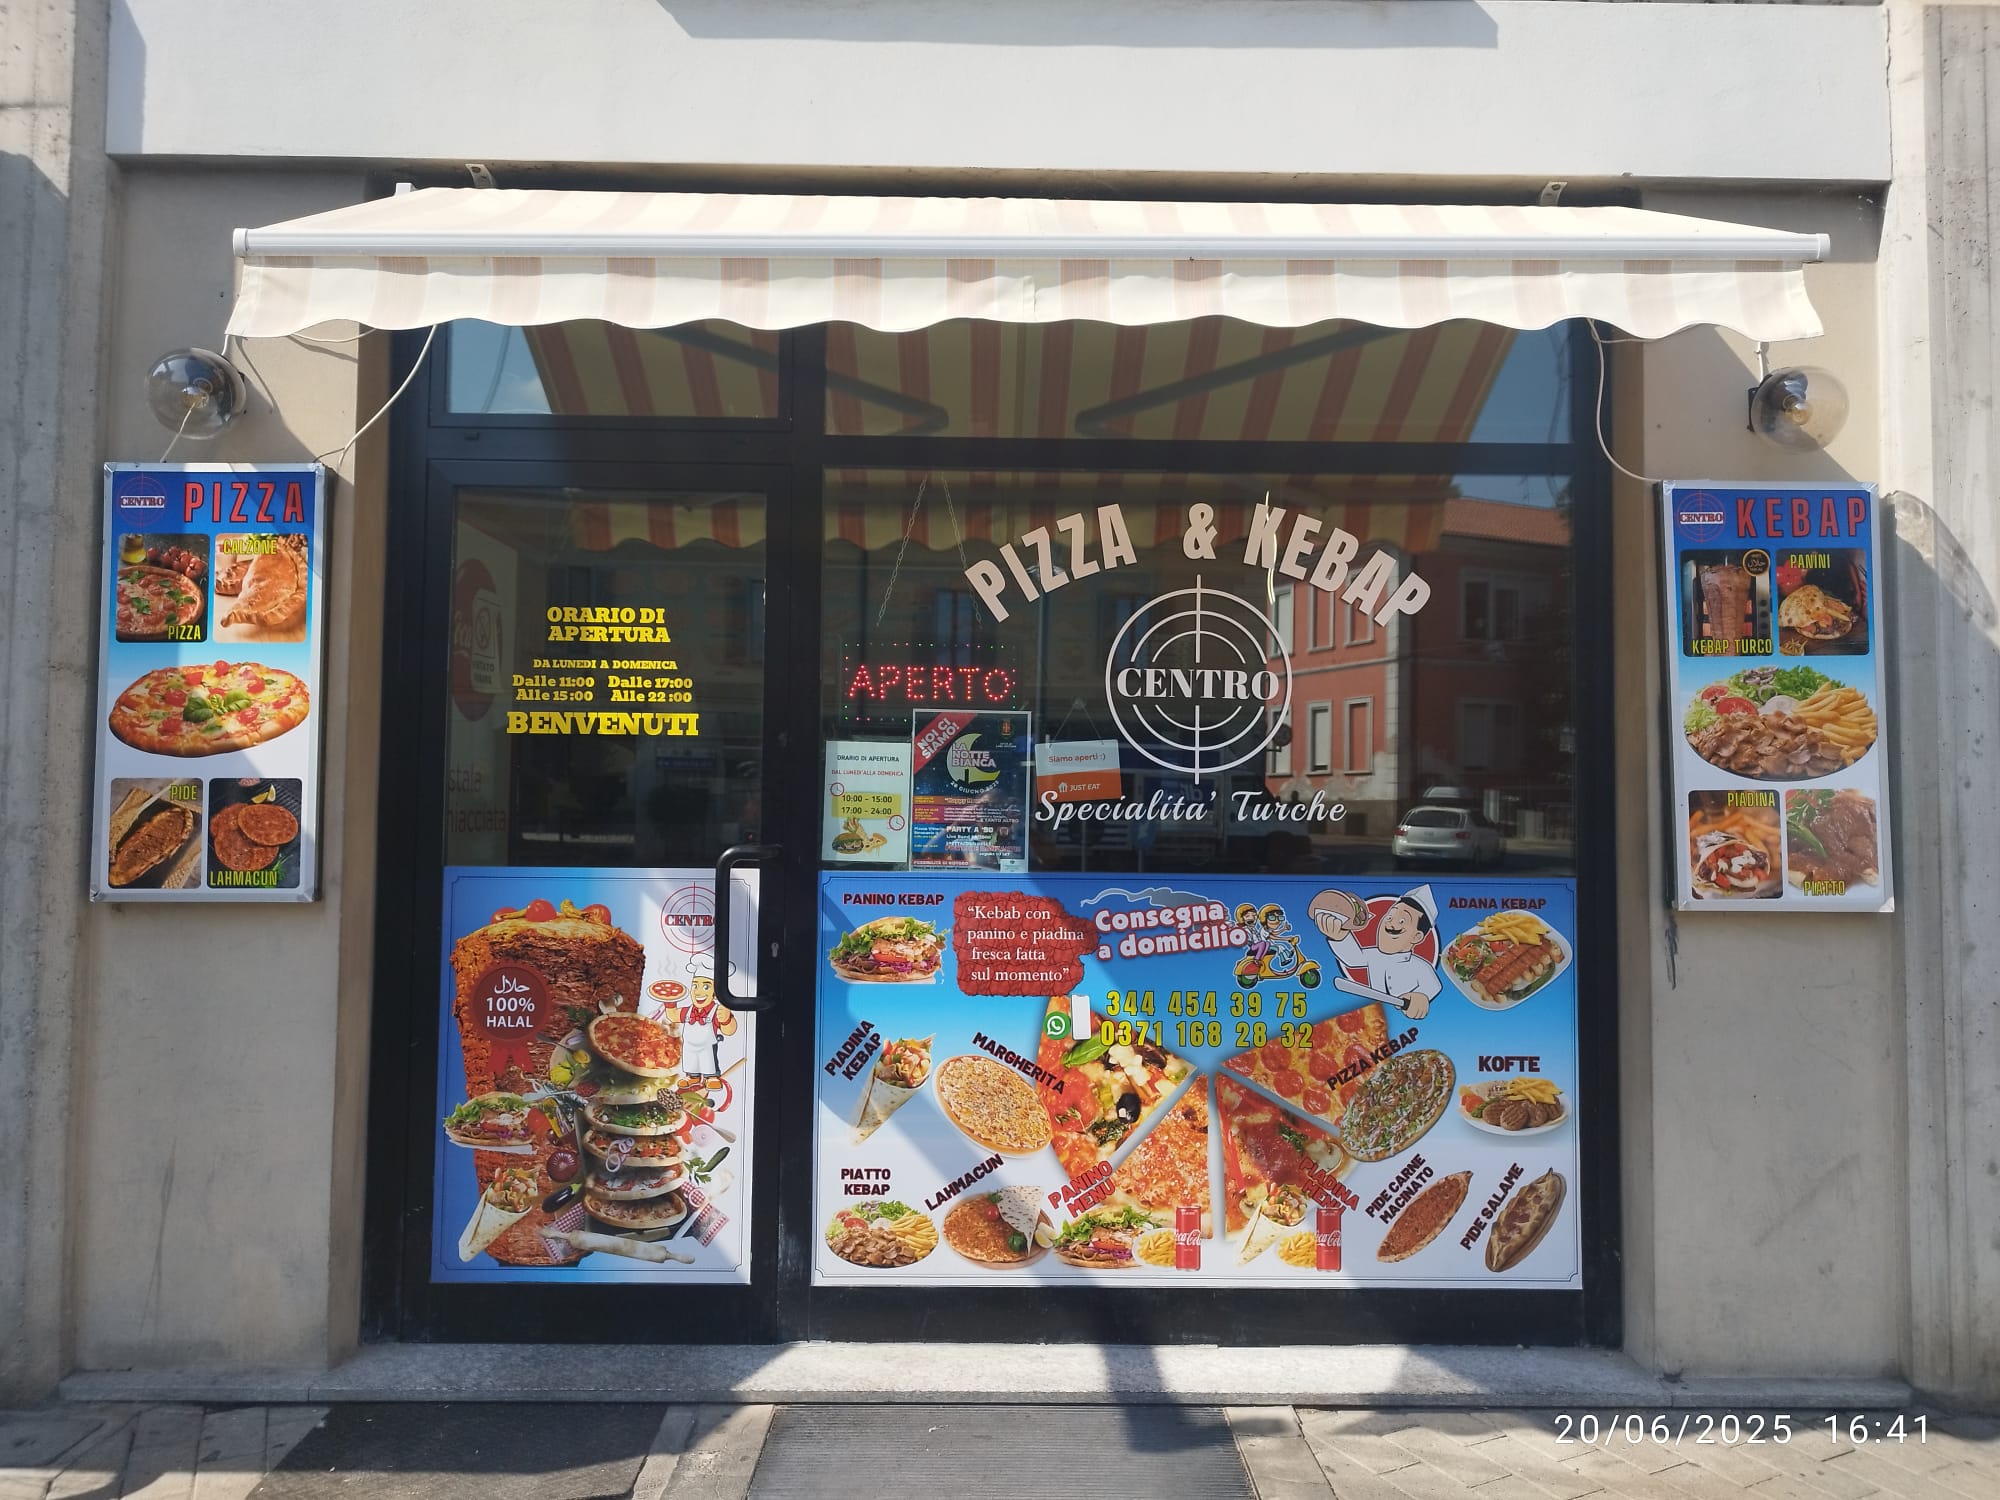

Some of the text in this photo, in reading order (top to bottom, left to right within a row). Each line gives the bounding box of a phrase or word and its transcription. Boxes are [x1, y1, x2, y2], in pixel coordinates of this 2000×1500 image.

[121, 496, 164, 506] CENTRO
[184, 482, 305, 523] PIZZA
[1680, 512, 1723, 523] CENTRO
[1736, 498, 1867, 538] KEBAP
[223, 539, 277, 555] CALZONE
[965, 503, 1431, 627] PIZZA & KEBAP
[1789, 554, 1831, 569] PANINI
[547, 607, 665, 623] ORARIO DI
[168, 625, 201, 640] PIZZA
[547, 625, 671, 643] APERTURA
[1692, 639, 1772, 654] KEBAP TURCO
[533, 659, 678, 670] DA LUNEDI A DOMENICA
[512, 674, 595, 688] Dalle 11:00
[607, 675, 693, 689] Dalle 17:00
[847, 664, 1011, 701] APERTO
[1117, 667, 1279, 700] CENTRO
[515, 689, 593, 702] Alle 15:00
[610, 690, 645, 702] Alle
[506, 711, 699, 737] BENVENUTI
[917, 717, 951, 750] NOI CI
[921, 722, 960, 759] SIAMO!
[952, 743, 967, 751] LA
[952, 751, 990, 759] NOTTE
[868, 755, 900, 763] APERTURA
[952, 758, 997, 768] BIANCA
[1048, 755, 1073, 763] Siamo
[1075, 753, 1098, 763] aperti
[170, 785, 197, 801] PIDE
[1070, 784, 1087, 792] JUST
[841, 794, 863, 803] 10:00
[871, 795, 893, 803] 15:00
[1727, 792, 1775, 807] PIADINA
[841, 806, 862, 815] 17:00
[870, 807, 892, 815] 24:00
[1035, 789, 1216, 830] Specialita'
[1231, 789, 1348, 822] Turche
[209, 870, 277, 886] LAHMACUN
[1803, 880, 1846, 896] PIATTO
[843, 893, 945, 906] PANINO KEBAP
[1449, 898, 1546, 910] ADANA KEBAP
[664, 914, 716, 926] CENTR
[1025, 909, 1050, 920] con
[1095, 902, 1226, 933] Consegna
[967, 928, 1085, 943] panino e piadina
[1098, 922, 1248, 961] a domicilio
[971, 947, 1045, 961] fresca fatta
[971, 967, 990, 981] sul
[494, 974, 530, 995] حلال
[486, 997, 535, 1013] 100%
[1106, 990, 1307, 1018] 344 454 39 75
[486, 1015, 534, 1029] HALAL
[1100, 1021, 1314, 1049] 0371 168 28 32
[824, 1020, 875, 1077] PIADINA
[842, 1032, 882, 1081] KEBAP
[972, 1032, 1066, 1094] MARGHERITA
[1327, 1027, 1420, 1091] PIZZA KEBAP
[1478, 1056, 1541, 1073] KOFTE
[841, 1168, 891, 1181] PIATTO
[924, 1153, 1005, 1211] LAHMACUN
[844, 1184, 891, 1196] KEBAP
[1047, 1160, 1113, 1210] PANINO
[1299, 1157, 1360, 1211] PIADINA
[1365, 1153, 1426, 1218] PIDE CARNE
[1066, 1178, 1116, 1218] MENU
[1379, 1166, 1434, 1224] MACINATO
[1460, 1162, 1525, 1250] PIDE SALAME
